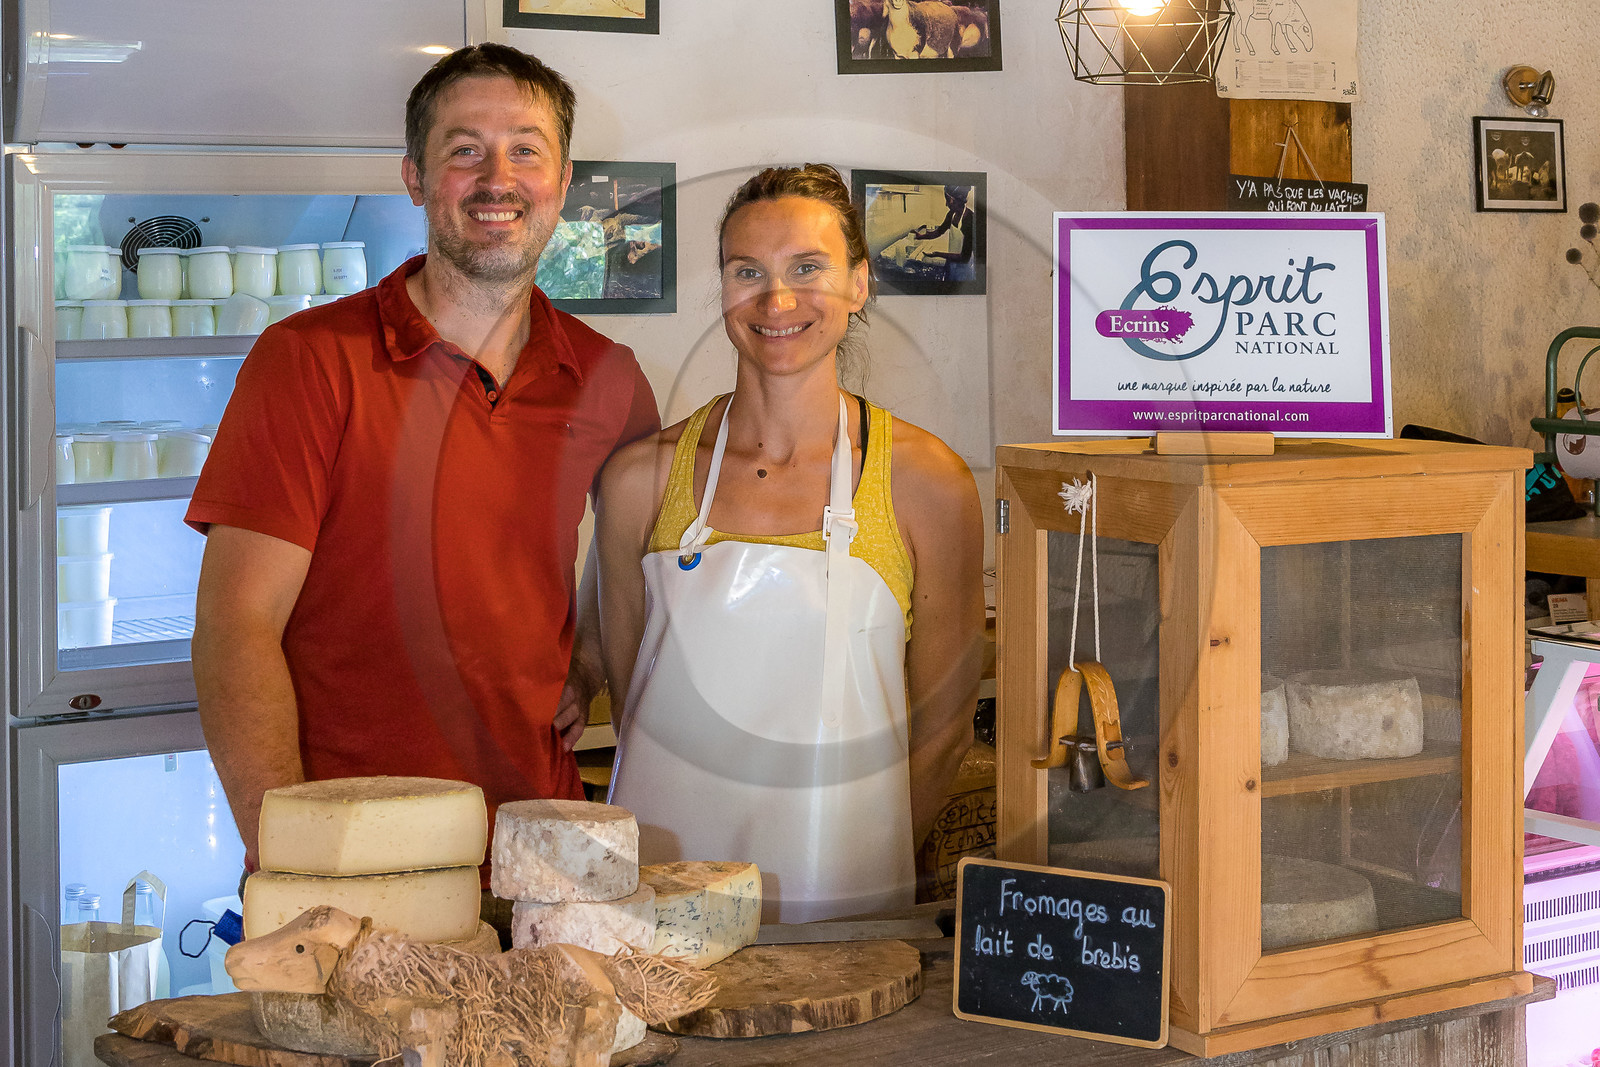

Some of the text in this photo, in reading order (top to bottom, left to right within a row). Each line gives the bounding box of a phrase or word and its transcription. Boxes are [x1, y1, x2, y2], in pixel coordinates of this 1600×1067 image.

[1236, 180, 1363, 205] Y'A PAS QUE LES VACHES
[1286, 201, 1307, 211] FONT
[1311, 203, 1322, 211] DU
[1110, 315, 1169, 332] Ecrins
[1235, 311, 1336, 337] PARC
[1235, 341, 1339, 355] NATIONAL
[1117, 376, 1331, 397] une marque inspirée par la nature
[1133, 409, 1309, 423] www.espritparcnational.com
[1000, 879, 1109, 940] Fromages
[1121, 907, 1156, 928] au
[975, 925, 1140, 972] lait de brebis
